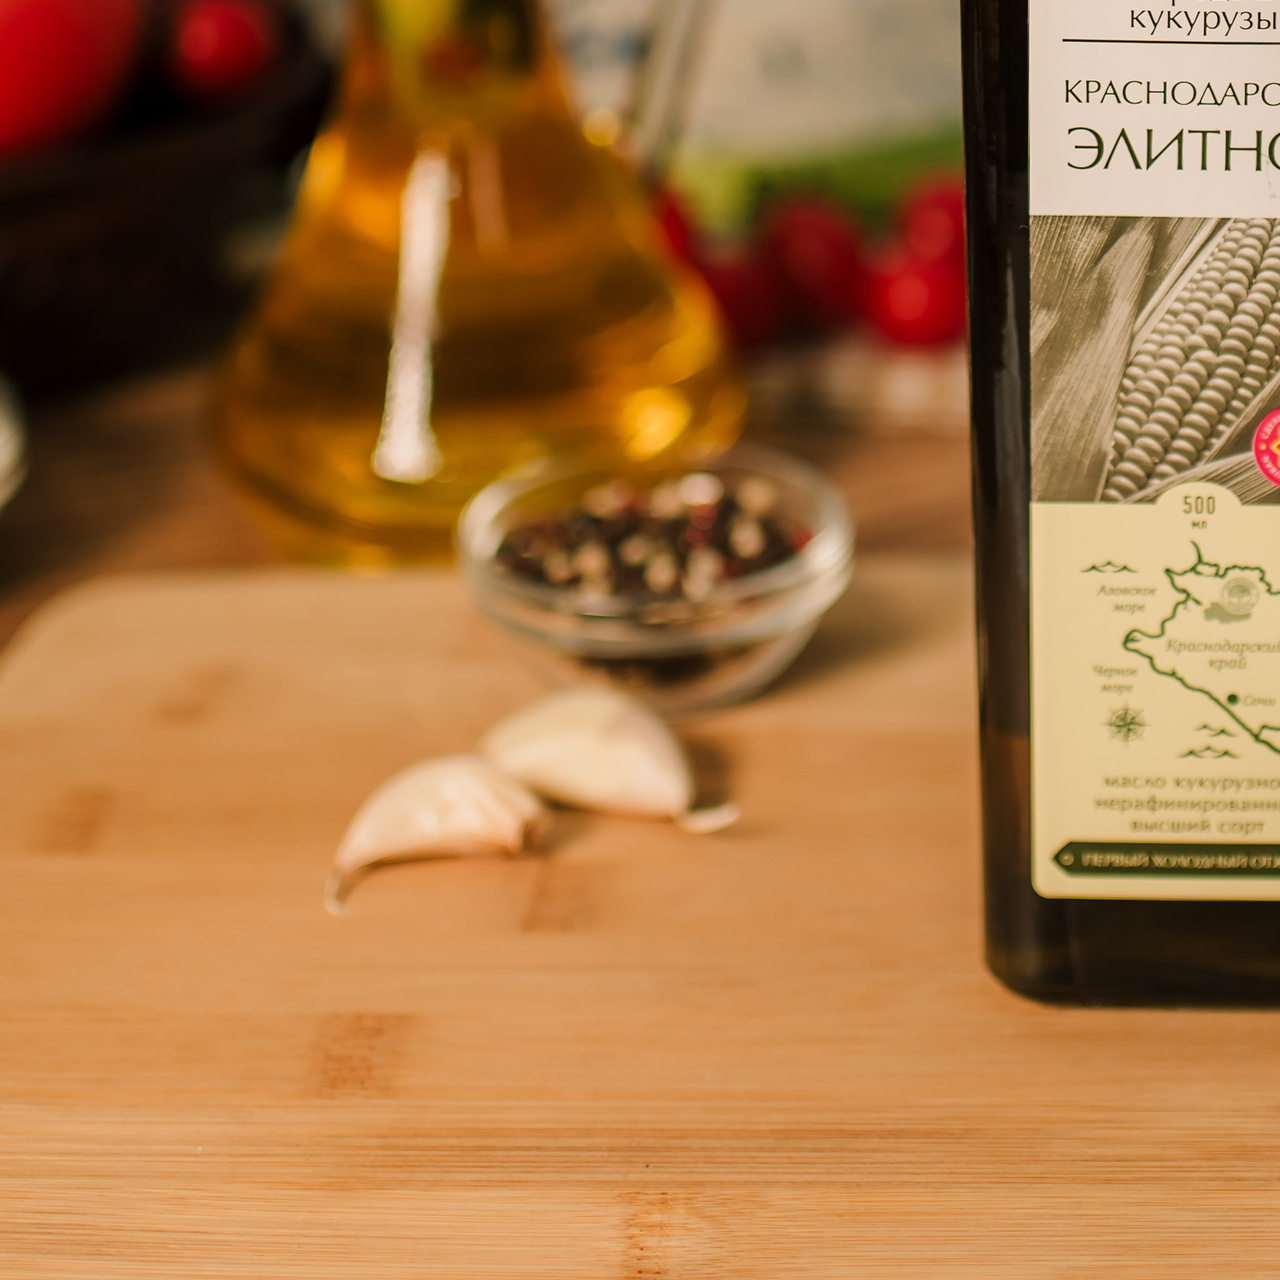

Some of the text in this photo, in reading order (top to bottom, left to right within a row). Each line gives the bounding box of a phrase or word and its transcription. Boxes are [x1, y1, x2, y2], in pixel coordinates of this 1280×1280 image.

[1130, 10, 1278, 36] кукурузы
[1183, 495, 1216, 515] 500
[1097, 584, 1158, 597] Азовское
[1112, 603, 1146, 615] море
[1208, 656, 1248, 669] край
[1100, 684, 1134, 695] море
[1242, 695, 1277, 706] Сочи
[1102, 775, 1167, 789] масло
[1129, 819, 1266, 836] высший сорт
[1081, 851, 1149, 868] ПЕРВЫЙ
